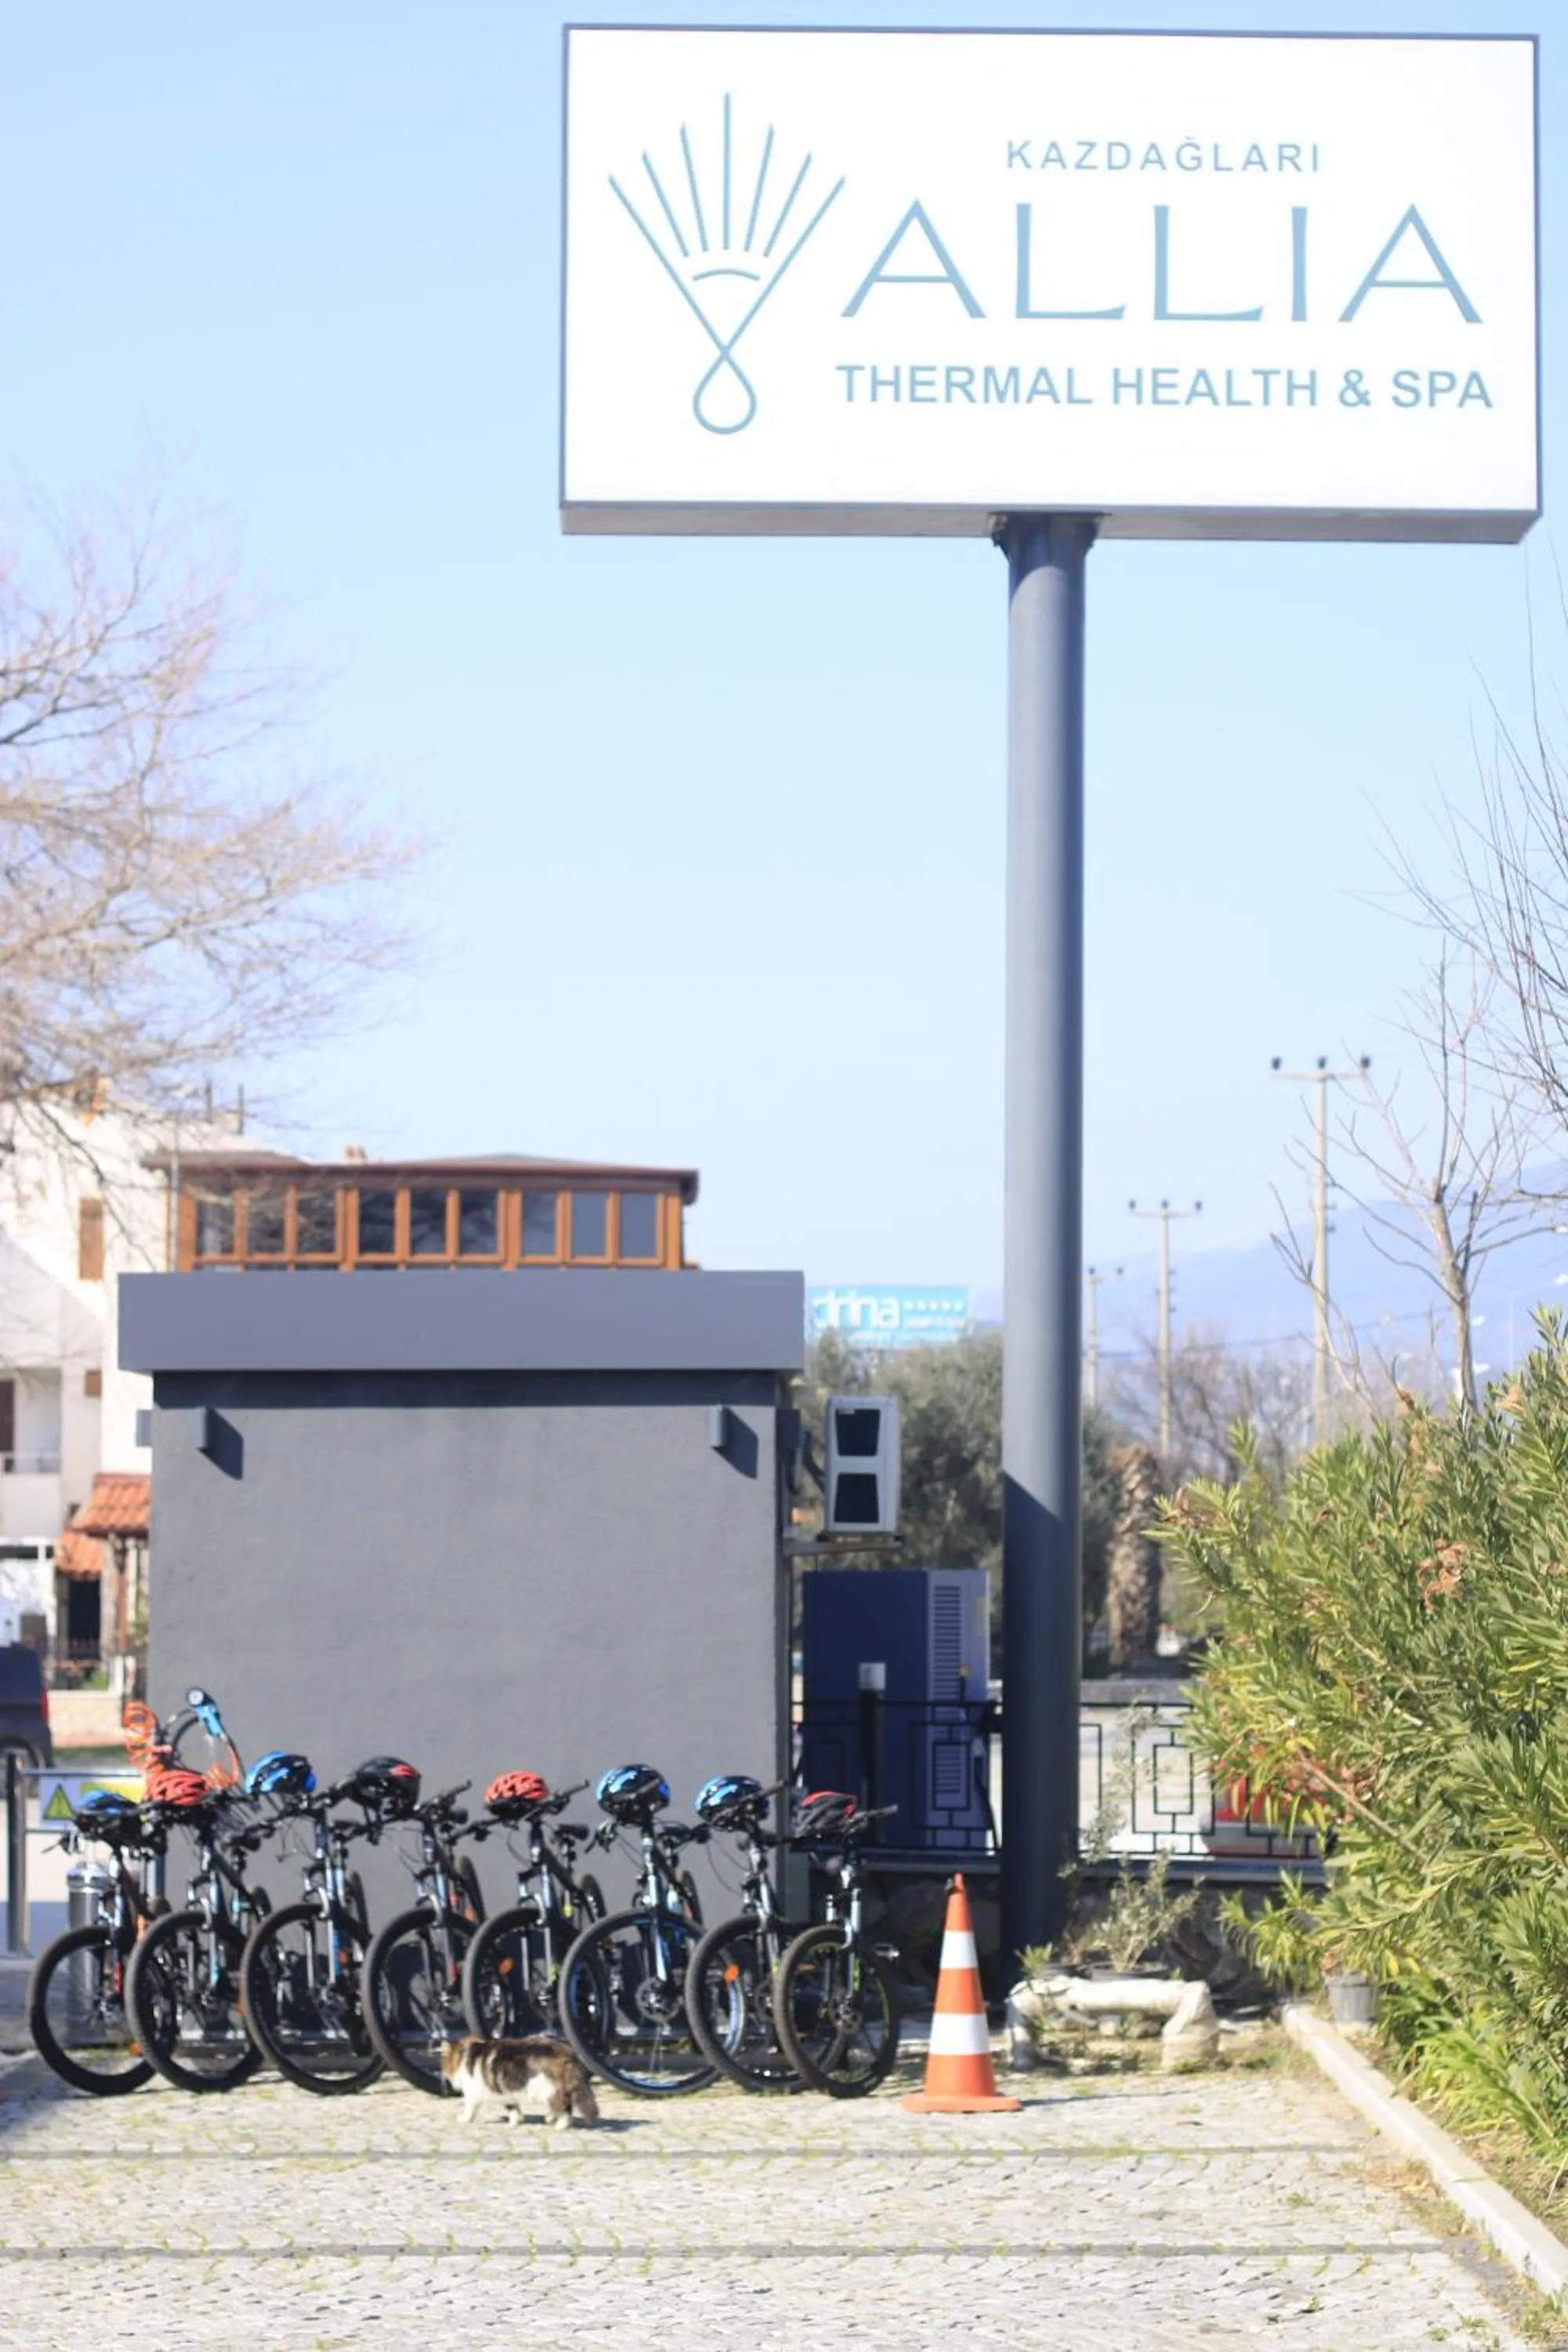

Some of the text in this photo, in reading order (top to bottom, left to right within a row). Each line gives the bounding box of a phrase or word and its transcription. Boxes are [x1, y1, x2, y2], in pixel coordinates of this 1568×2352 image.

[1007, 136, 1320, 172] KAZDAĞLARI
[840, 197, 1483, 324] ALLIA
[836, 363, 1494, 409] THERMAL HEALTH & SPA
